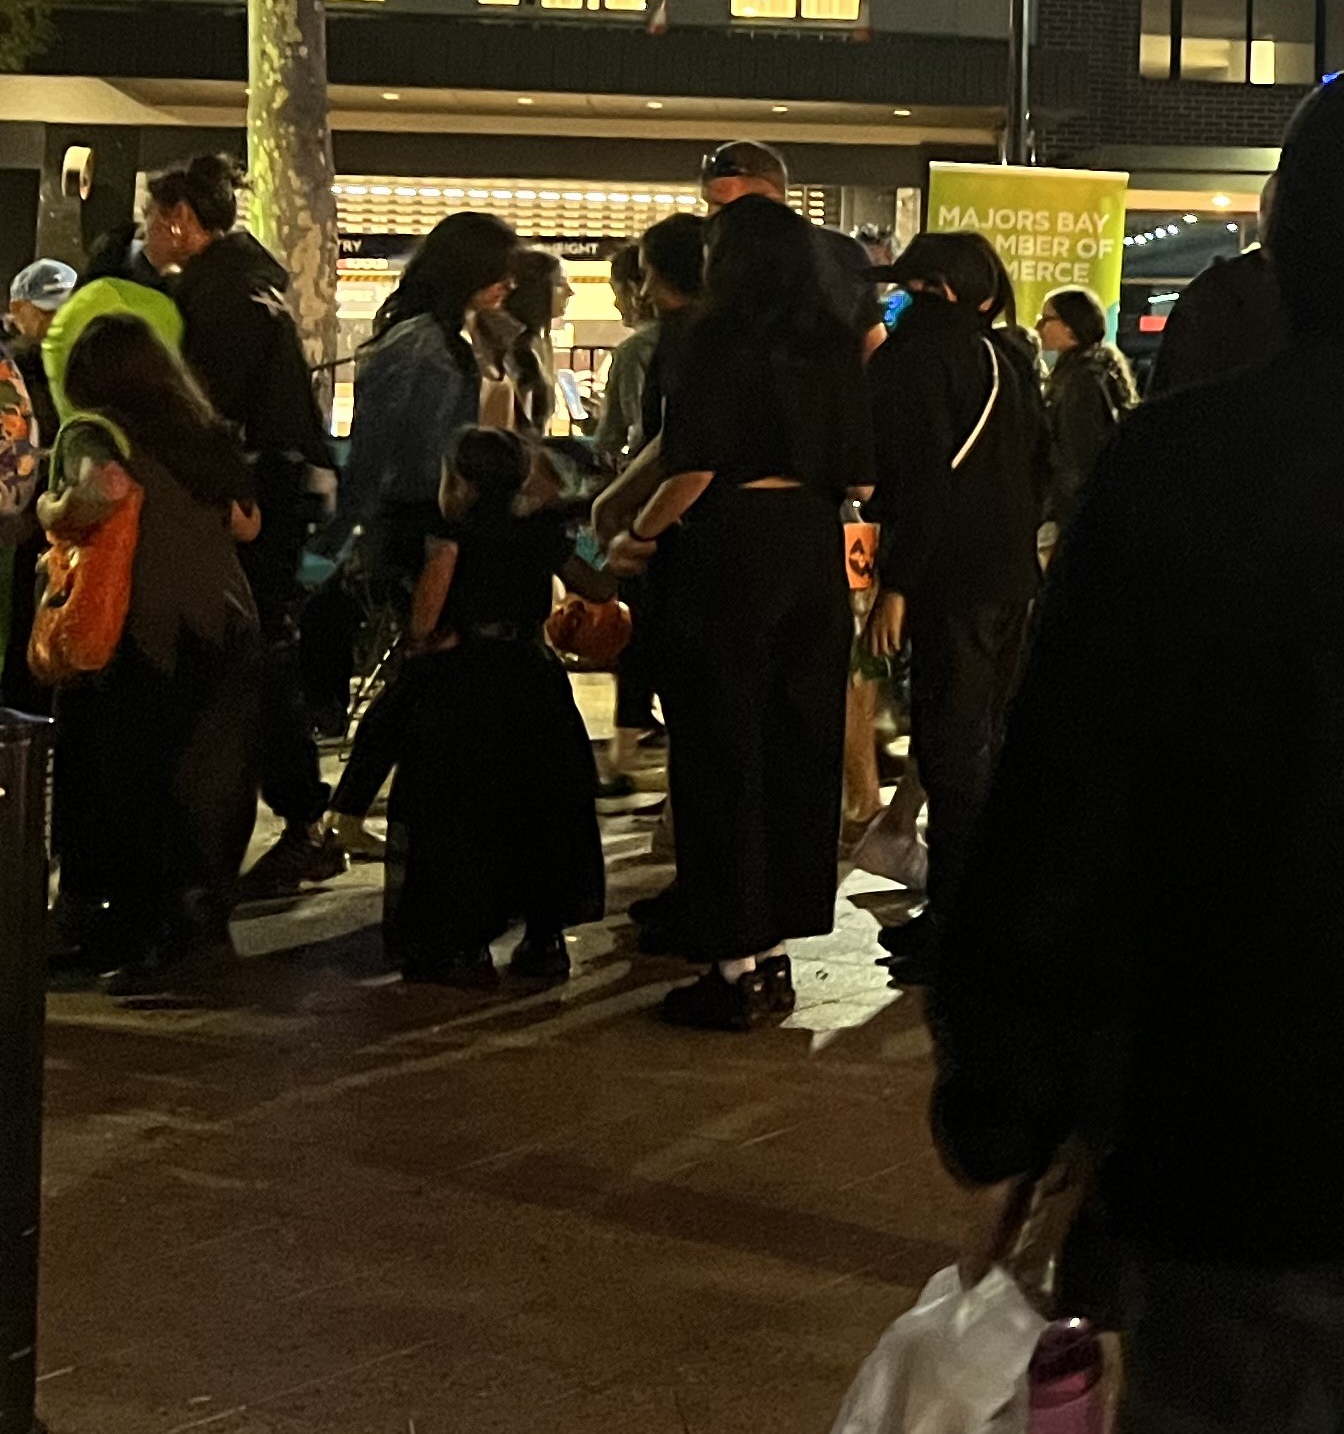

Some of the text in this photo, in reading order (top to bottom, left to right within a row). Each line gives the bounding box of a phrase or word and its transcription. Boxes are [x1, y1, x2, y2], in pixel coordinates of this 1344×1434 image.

[938, 205, 1110, 234] MAJORS BAY
[995, 233, 1114, 260] MBER OF
[1008, 259, 1090, 283] MERCE
